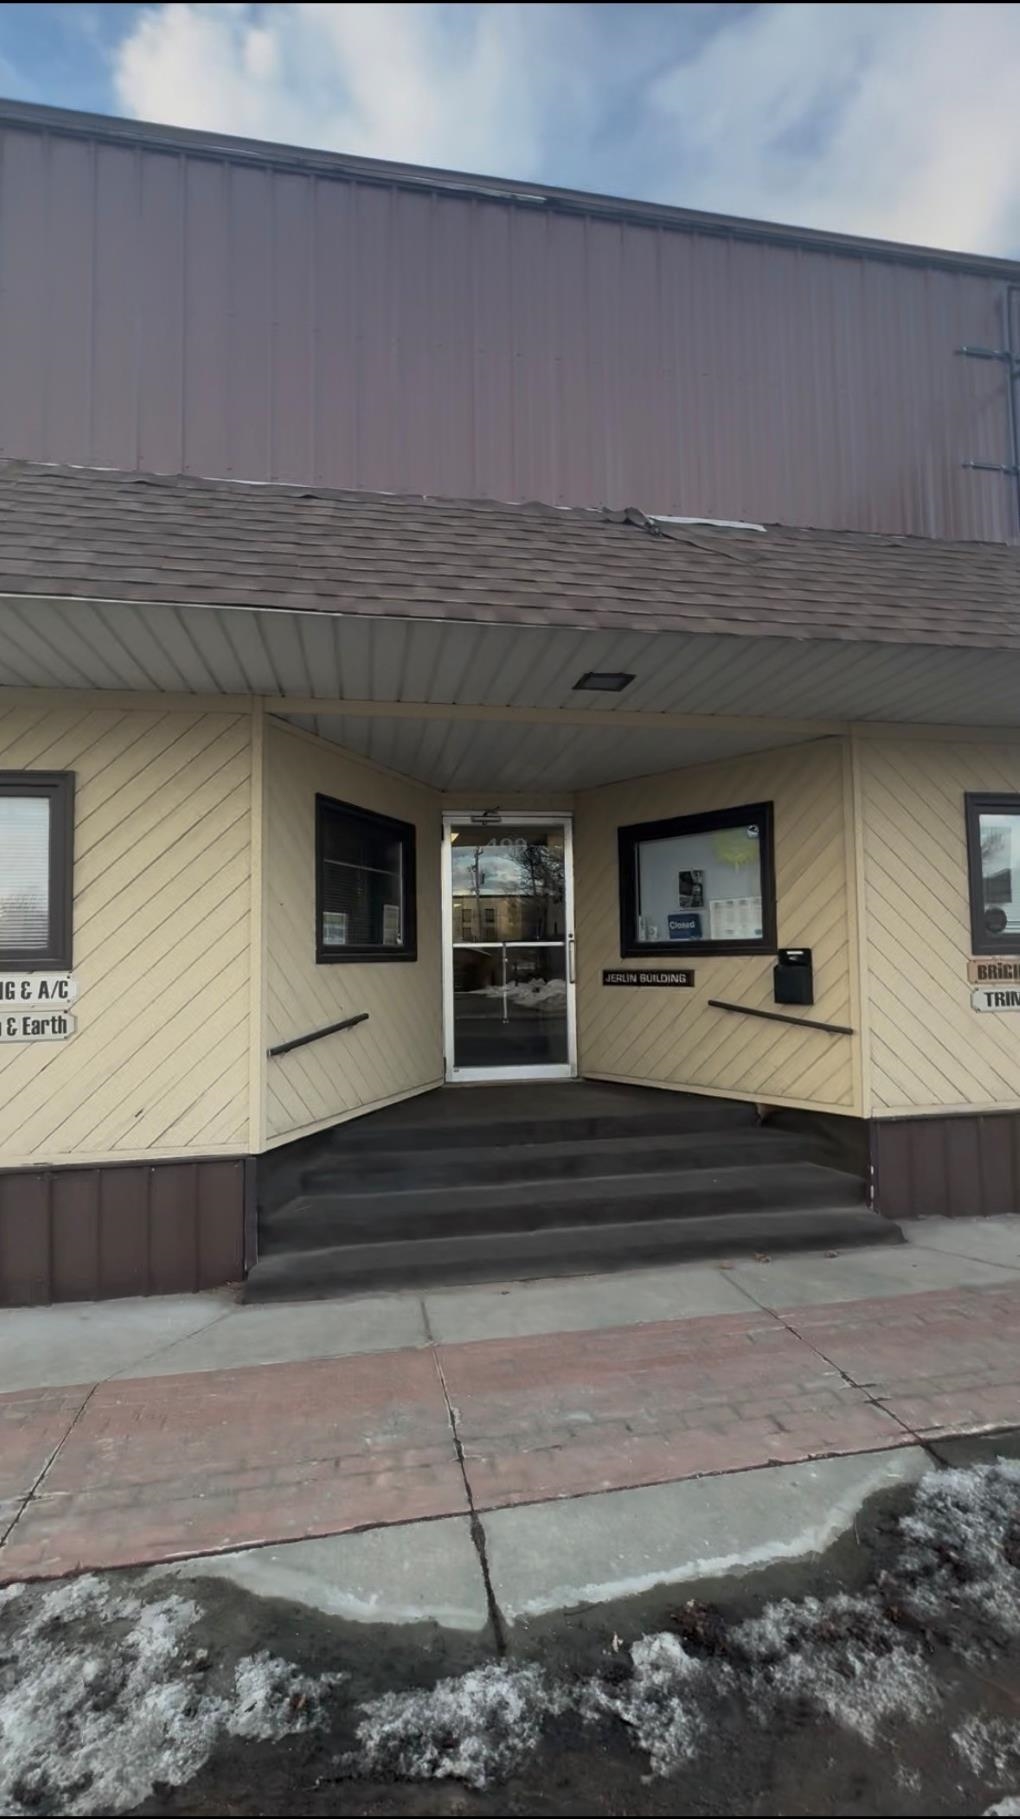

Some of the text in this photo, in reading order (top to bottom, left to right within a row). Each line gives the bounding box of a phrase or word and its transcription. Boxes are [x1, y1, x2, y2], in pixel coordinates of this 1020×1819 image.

[669, 920, 696, 929] Closed
[606, 973, 686, 983] JERLIN BUILDING
[21, 981, 32, 999] &
[38, 980, 68, 999] A/C
[7, 1017, 17, 1036] &
[22, 1015, 67, 1035] Earth
